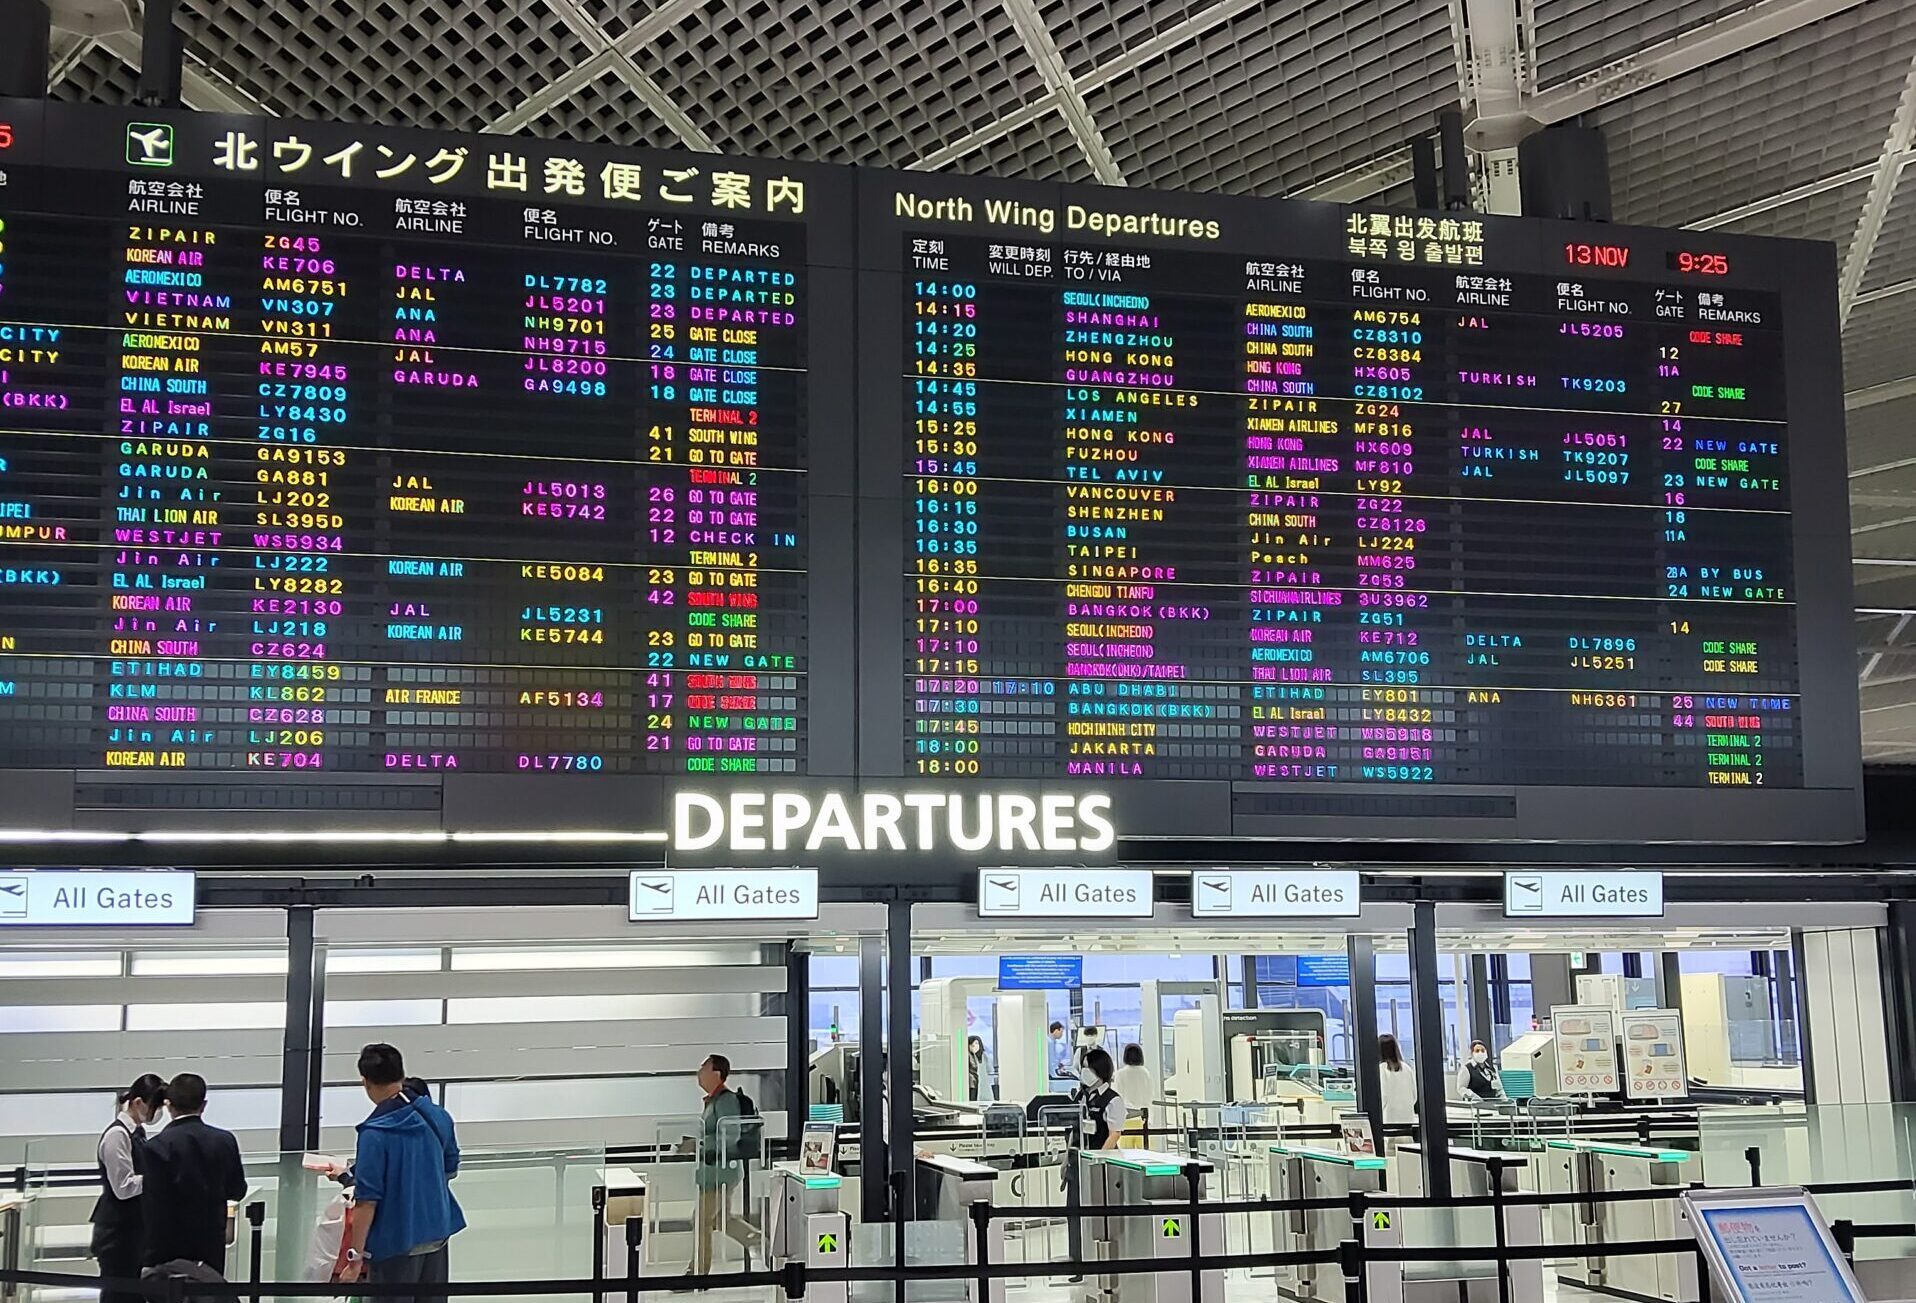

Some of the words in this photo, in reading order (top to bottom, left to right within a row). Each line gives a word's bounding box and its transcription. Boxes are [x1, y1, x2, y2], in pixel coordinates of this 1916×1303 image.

[128, 179, 204, 199] 航空会社
[264, 188, 300, 206] 便名
[128, 198, 199, 215] AIRLINE
[395, 197, 467, 218] 航空会社
[265, 207, 328, 224] FLIGHT
[333, 212, 364, 226] NO.
[523, 207, 557, 225] 便名
[895, 192, 973, 222] North
[984, 199, 1054, 233] Wing
[1067, 205, 1220, 239] Departures
[395, 216, 463, 234] AIRLINE
[647, 218, 683, 235] ゲート
[701, 222, 735, 239] 備考
[1346, 212, 1484, 244] 北翼出发航班
[129, 226, 215, 245] ZIPAIR
[524, 225, 584, 243] FLIGHT
[589, 231, 618, 245] NO.
[648, 235, 683, 251] GATE
[264, 235, 320, 253] ZG45
[702, 239, 780, 258] REMARKS
[912, 238, 944, 255] 定刻
[1348, 236, 1388, 259] 북쪽
[1396, 239, 1416, 261] 윙
[1423, 241, 1483, 265] 출발편
[126, 247, 173, 264] KOREAN
[177, 250, 203, 267] AIR
[988, 244, 1051, 263] 変更時刻
[1064, 250, 1151, 269] 行先/経由地
[1565, 244, 1592, 264] 13
[1594, 245, 1629, 268] NOV
[263, 256, 335, 275] KE706
[650, 263, 675, 279] 22
[912, 255, 949, 271] TIME
[989, 261, 1021, 276] WILL
[1025, 264, 1054, 278] DEP.
[1245, 261, 1305, 279] 航空会社
[1678, 252, 1728, 275] 9:25
[396, 265, 465, 282] DELTA
[691, 266, 795, 286] DEPARTED
[1064, 266, 1085, 280] TO
[1097, 268, 1122, 282] VIA
[1351, 268, 1380, 284] 便名
[262, 277, 346, 297] AM6751
[525, 274, 607, 294] DL7782
[915, 281, 976, 299] 14:00
[1246, 278, 1302, 293] AIRLINE
[1455, 275, 1513, 292] 航空会社
[1556, 282, 1584, 297] 便名
[126, 290, 231, 309] VIETNAM
[396, 286, 436, 301] JAL
[1352, 285, 1402, 300] FLIGHT
[1406, 288, 1430, 301] NO.
[1456, 291, 1510, 306] AIRLINE
[1654, 289, 1683, 304] ゲート
[1697, 292, 1724, 307] 備考
[261, 298, 334, 316] VN307
[525, 295, 604, 314] JL5201
[1558, 298, 1606, 312] FLIGHT
[1609, 301, 1632, 315] NO.
[1655, 304, 1685, 318] GATE
[691, 306, 795, 325] DEPARTED
[1066, 311, 1158, 328] SHANGHAI
[1353, 309, 1421, 326] AM6754
[1698, 308, 1761, 324] REMARKS
[0, 326, 59, 342] CITY
[650, 323, 675, 340] 25
[689, 326, 718, 342] GATE
[722, 328, 757, 345] CLOSE
[1065, 330, 1173, 348] ZHENGZHOU
[1559, 323, 1623, 338] JL5205
[1065, 349, 1113, 364] HONG
[1127, 353, 1173, 367] KONG
[1659, 346, 1679, 360] 12
[259, 362, 347, 381] KE7945
[916, 360, 976, 377] 14:35
[121, 376, 161, 392] CHINA
[166, 378, 207, 395] SOUTH
[394, 370, 478, 387] GARUDA
[524, 378, 606, 396] GA9498
[1458, 371, 1536, 387] TURKISH
[1561, 377, 1626, 393] TK9203
[259, 383, 347, 402] CZ7809
[650, 384, 675, 400] 18
[1067, 388, 1101, 402] LOS
[1115, 391, 1198, 407] ANGELES
[915, 399, 976, 417] 14:55
[1066, 408, 1137, 423] XIAMEN
[1661, 400, 1681, 414] 27
[649, 425, 672, 441] 41
[688, 427, 725, 444] SOUTH
[729, 430, 758, 446] WING
[1354, 422, 1412, 437] MF816
[120, 441, 209, 459] GARUDA
[915, 439, 977, 456] 15:30
[257, 447, 346, 466] GA9153
[392, 475, 433, 490] JAL
[1066, 466, 1101, 480] TEL
[1116, 468, 1163, 482] AVIV
[523, 481, 605, 499] JL5013
[649, 487, 675, 502] 26
[1066, 485, 1175, 502] VANCOUVER
[1357, 479, 1402, 494] LY92
[116, 506, 146, 522] THAI
[153, 508, 187, 524] LION
[192, 510, 218, 525] AIR
[256, 512, 343, 529] SL395D
[916, 518, 978, 535] 16:30
[1067, 524, 1126, 539] BUSAN
[115, 528, 222, 545] WESTJET
[690, 530, 755, 545] CHECK
[689, 550, 744, 567] TERMINAL
[748, 552, 758, 567] 2
[1067, 544, 1136, 559] TAIPEI
[1068, 564, 1176, 580] SINGAPORE
[1700, 567, 1720, 579] BY
[1733, 568, 1763, 581] BUS
[916, 618, 978, 634] 17:10
[1569, 637, 1636, 651] DL7896
[111, 661, 202, 678] ETIHAD
[250, 686, 325, 702] KL862
[385, 688, 410, 704] AIR
[415, 689, 461, 705] FRANCE
[1468, 691, 1501, 703] ANA
[1070, 742, 1155, 755] JAKARTA
[106, 751, 155, 766] KOREAN
[159, 751, 186, 767] AIR
[519, 755, 602, 770] DL7780
[687, 757, 715, 772] CODE
[720, 757, 756, 772] SHARE
[917, 759, 979, 774] 18:00
[1362, 766, 1433, 780] WS5922
[1708, 771, 1752, 785] TERMINAL
[1755, 772, 1763, 785] 2
[674, 792, 1115, 852] DEPARTURES
[53, 886, 87, 910] All
[96, 885, 173, 911] Gates
[695, 883, 726, 906] All
[733, 883, 800, 906] Gates
[1040, 883, 1067, 902] All
[1075, 883, 1137, 903] Gates
[1251, 884, 1275, 902] All
[1284, 884, 1344, 904] Gates
[1561, 885, 1585, 903] All
[1592, 884, 1648, 903] Gates
